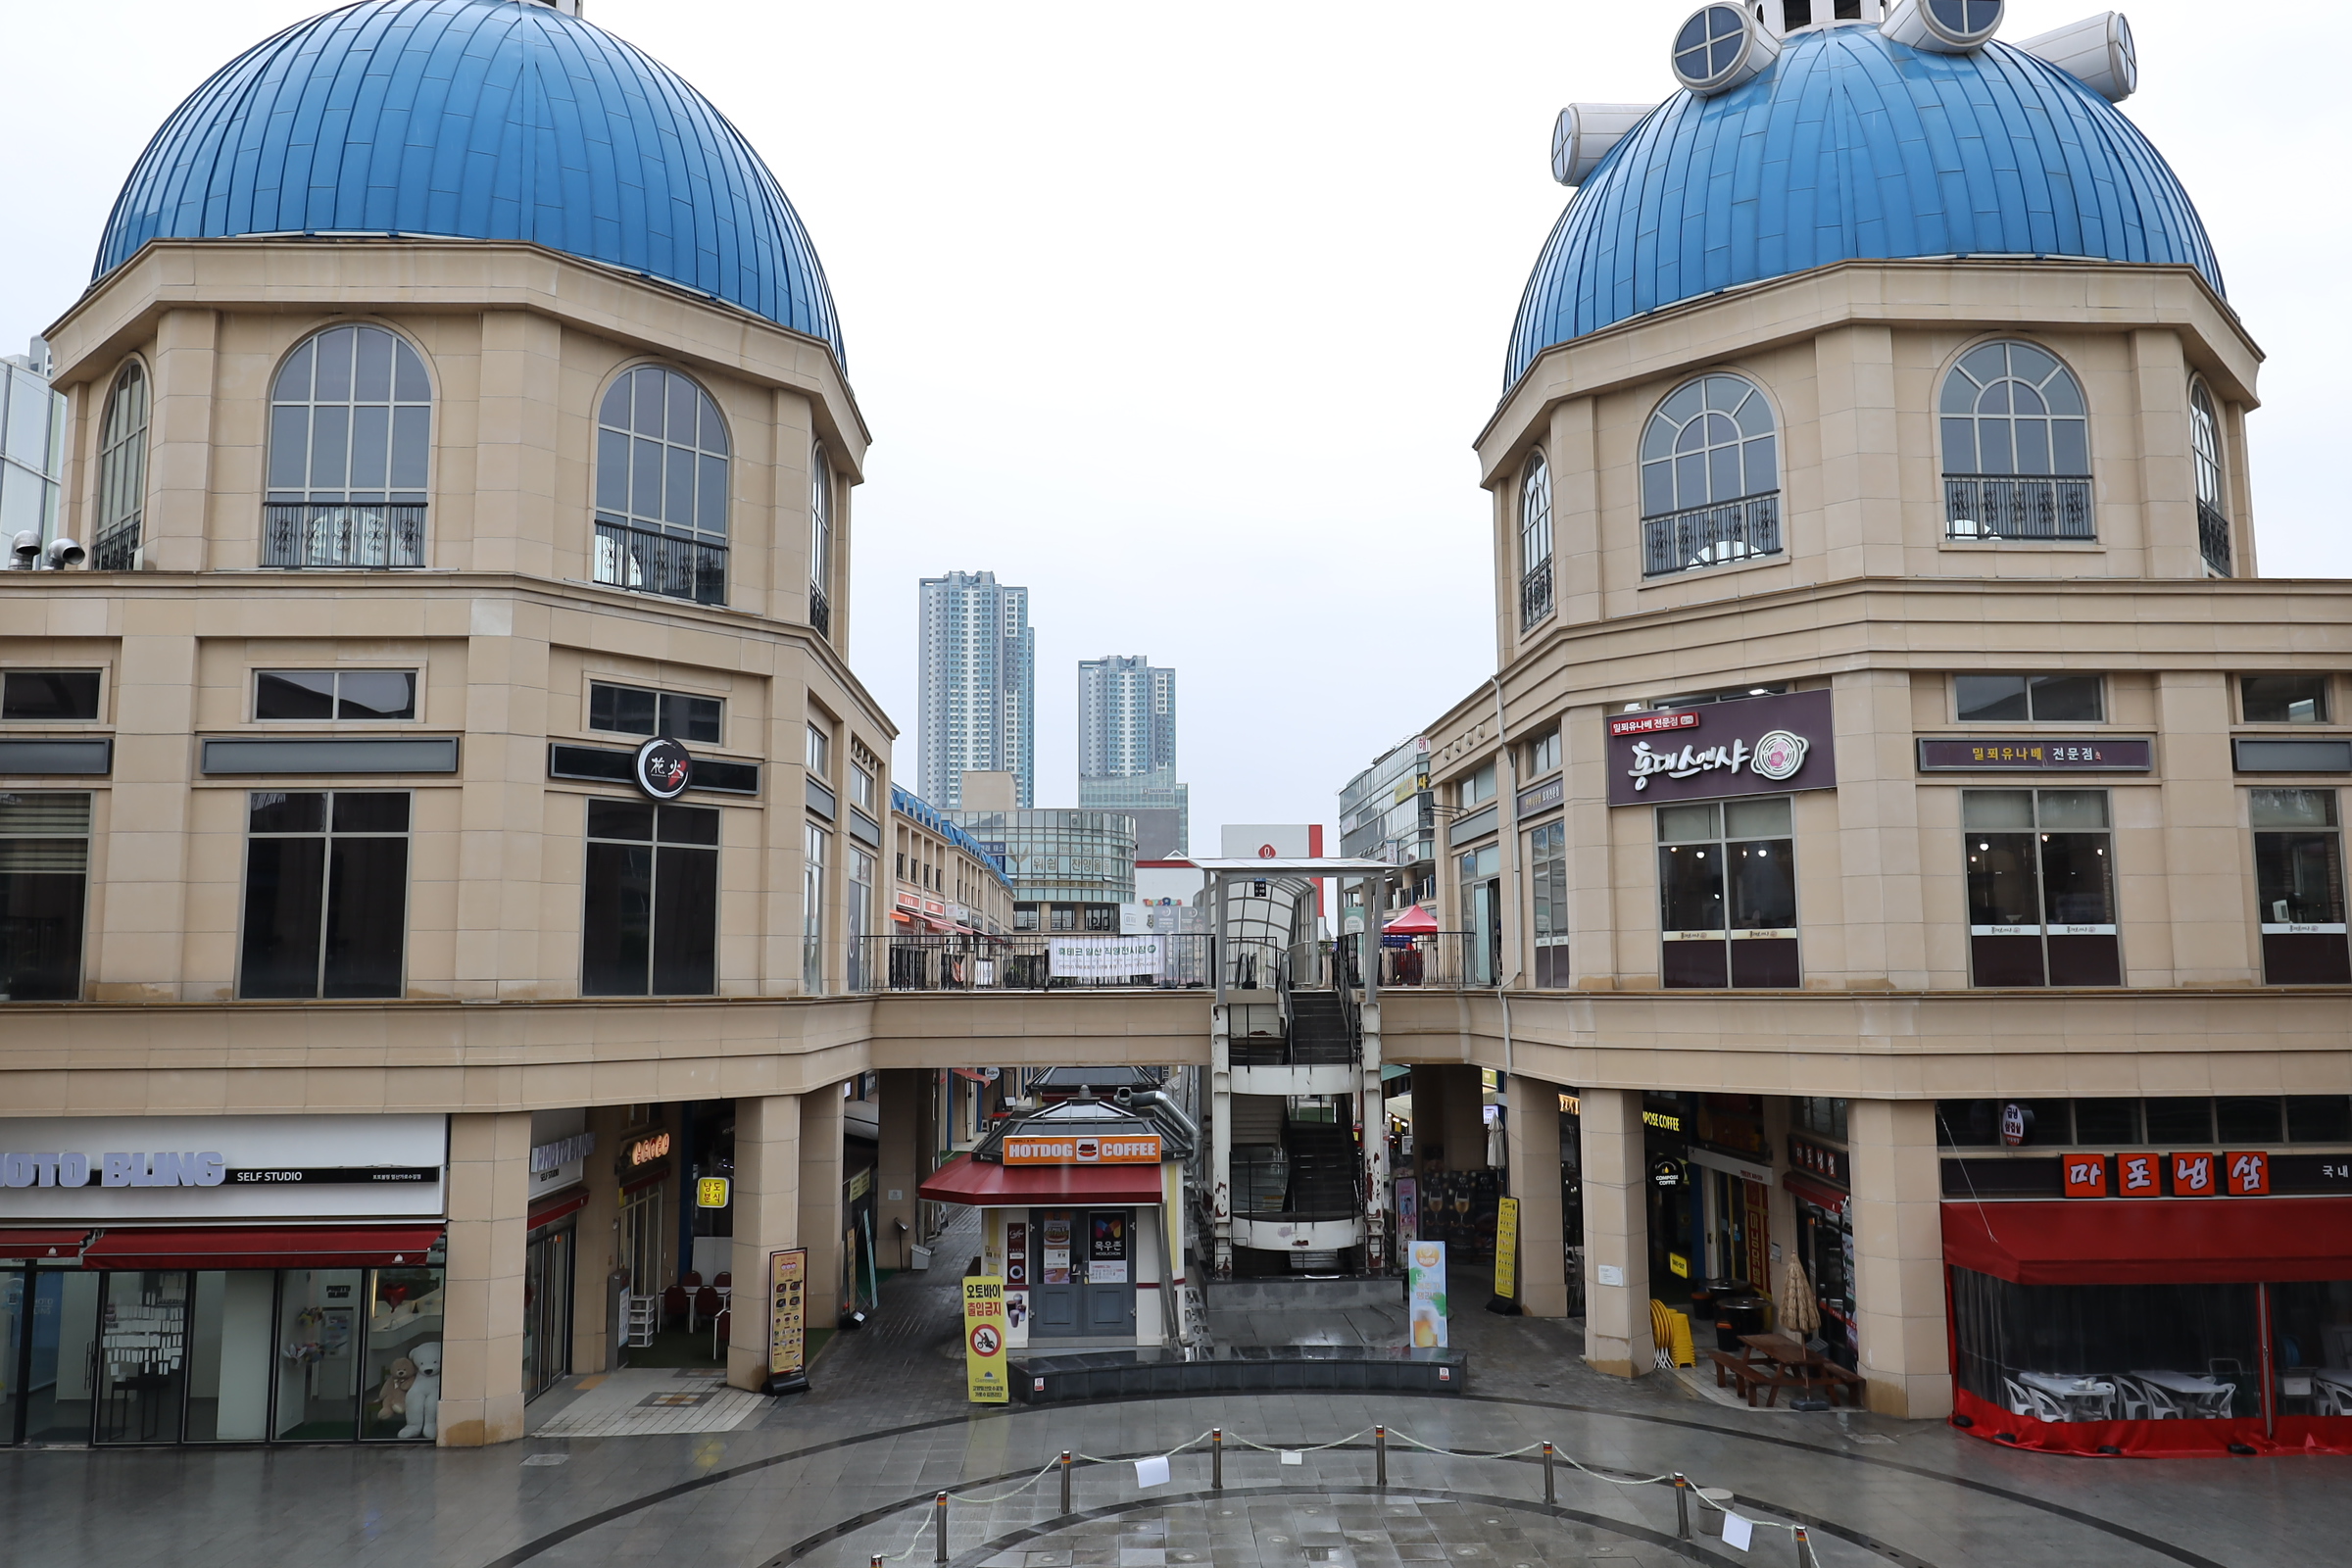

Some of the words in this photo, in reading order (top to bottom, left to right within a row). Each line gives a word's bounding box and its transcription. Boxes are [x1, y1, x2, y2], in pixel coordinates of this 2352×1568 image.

[1653, 716, 1678, 729] 전문점
[2053, 747, 2093, 760] 전문점
[1659, 1114, 1680, 1131] COFFEE
[1008, 1144, 1073, 1157] HOTDOG
[1102, 1143, 1156, 1156] COFFEE
[101, 1152, 226, 1187] BLING
[237, 1172, 262, 1182] SELF
[264, 1171, 302, 1181] STUDIO
[704, 1182, 721, 1192] 낭도
[704, 1193, 720, 1203] 분식
[1095, 1241, 1122, 1251] 목우촌
[966, 1284, 1001, 1298] 오토바이
[967, 1301, 1002, 1316] 출입금지
